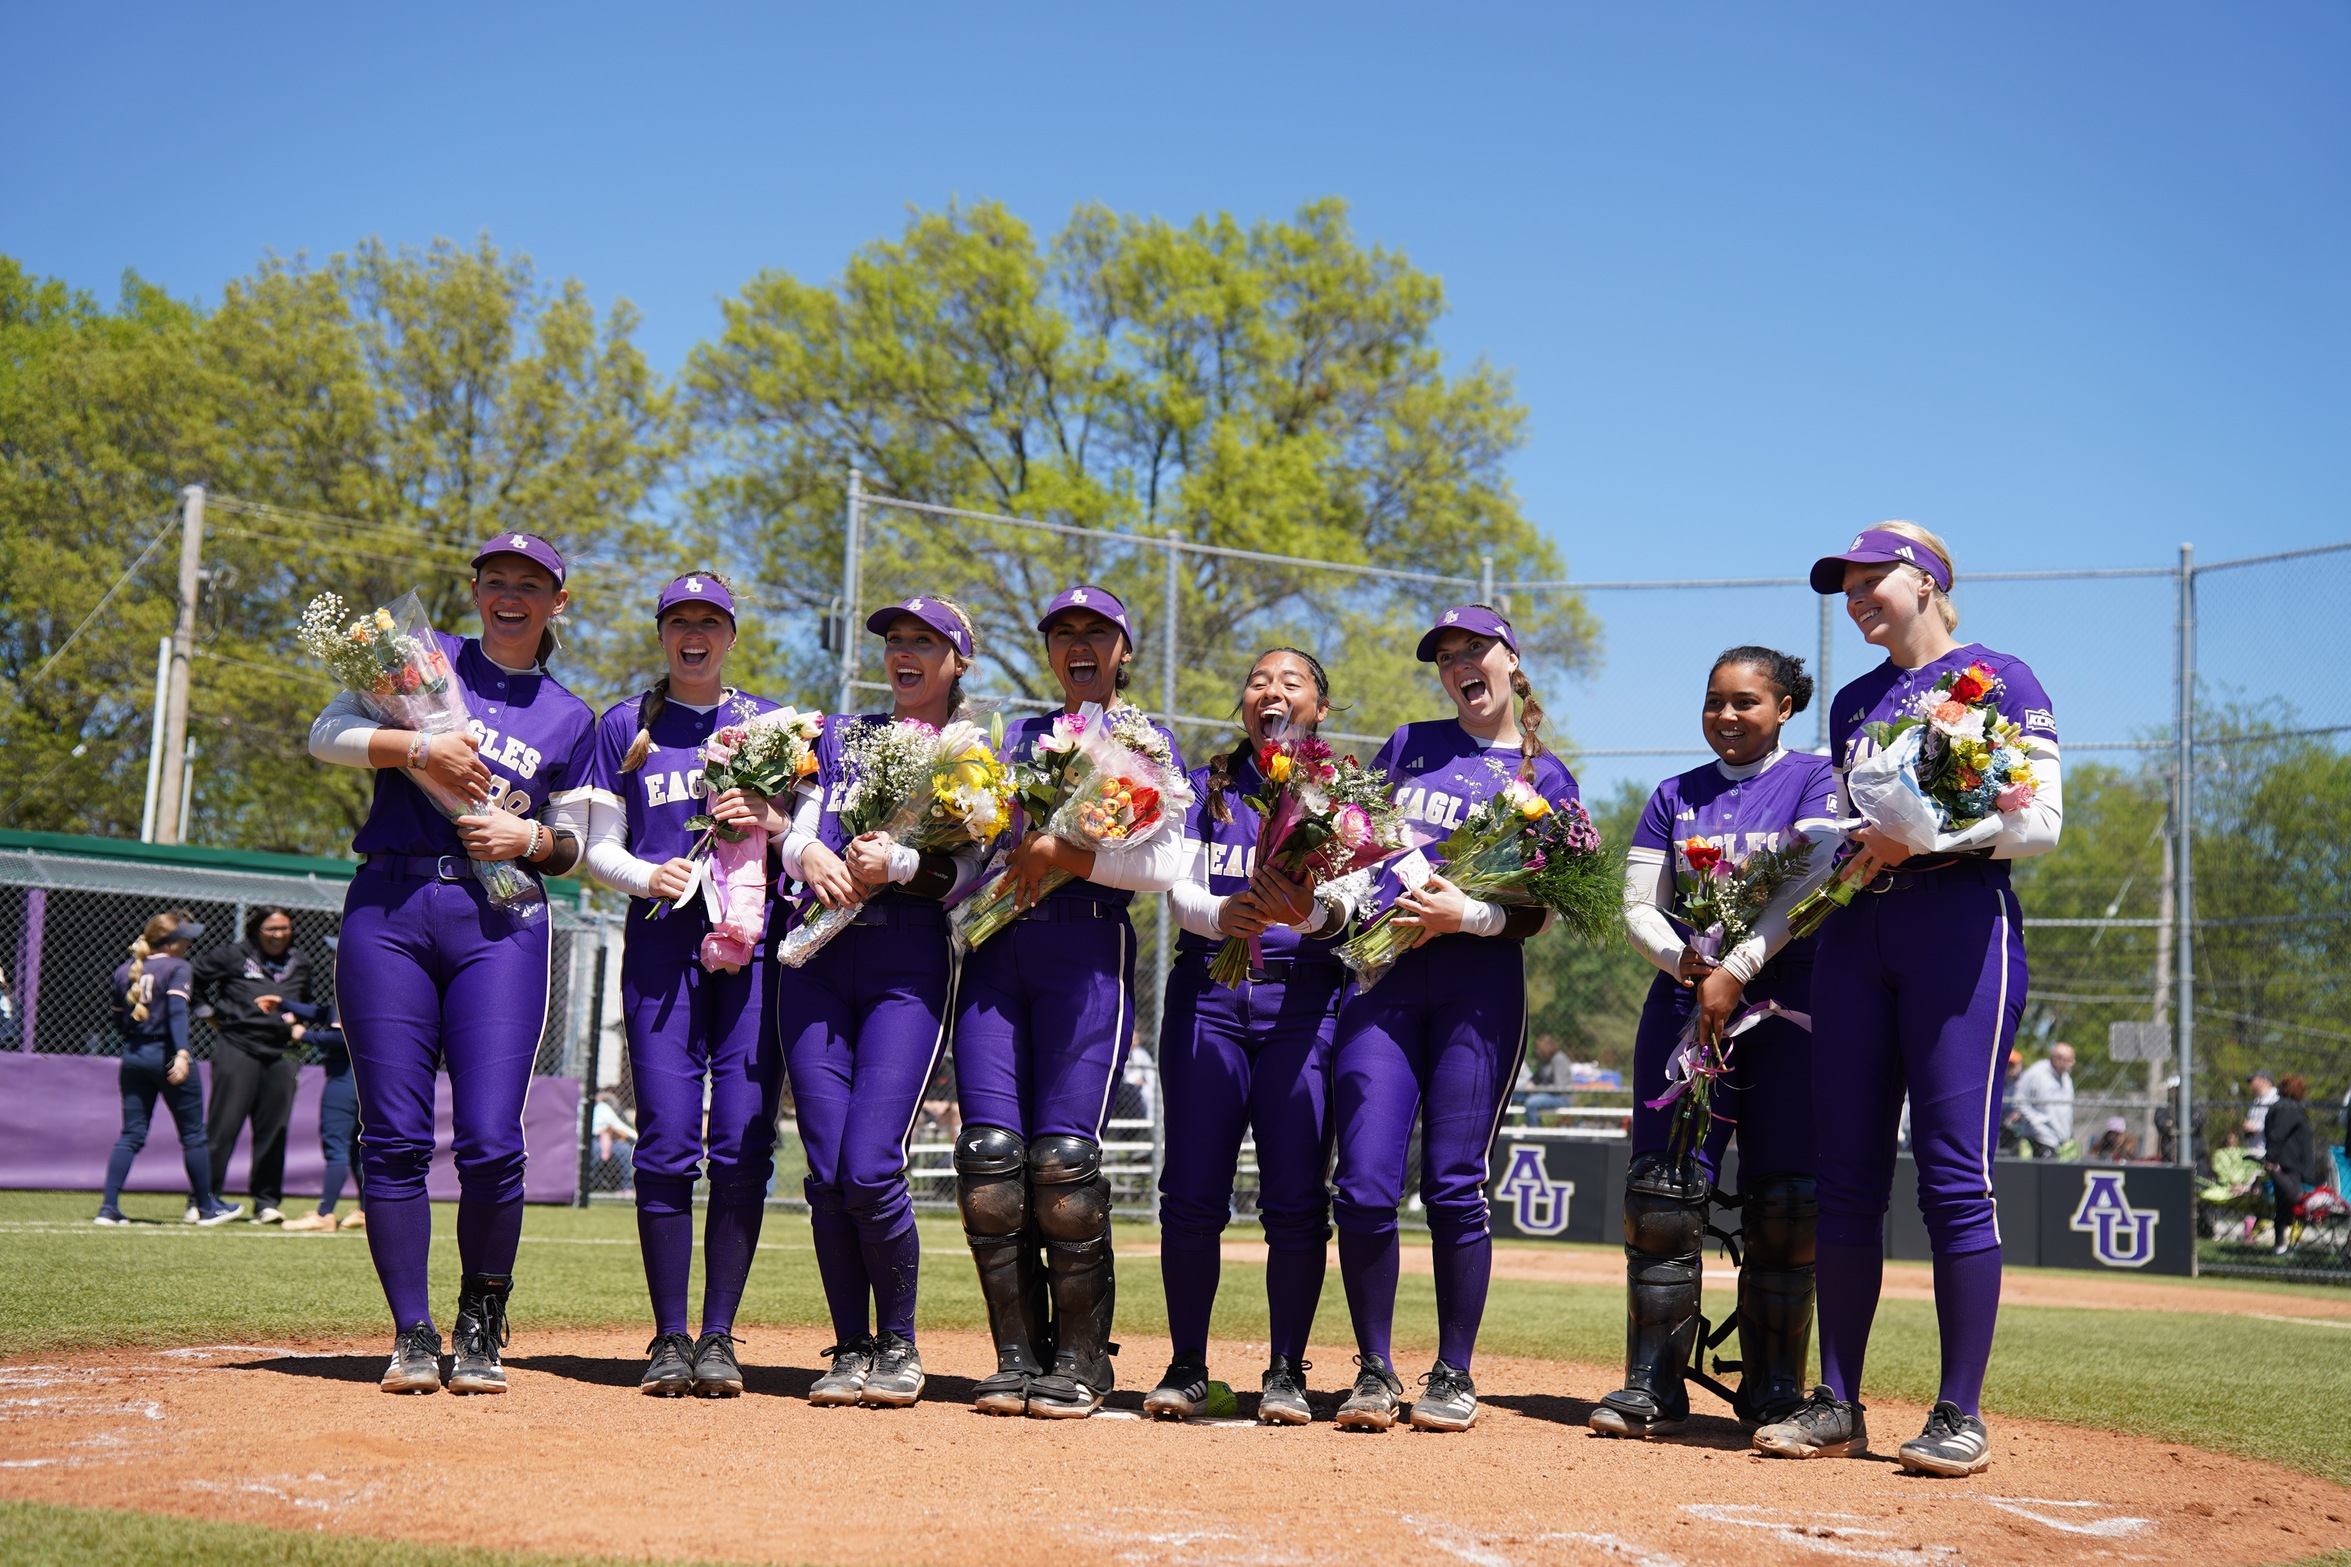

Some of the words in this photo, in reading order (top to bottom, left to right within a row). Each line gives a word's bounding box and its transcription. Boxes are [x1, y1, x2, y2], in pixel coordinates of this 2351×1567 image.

[467, 719, 541, 780] GLES
[644, 768, 708, 808] EAG
[1394, 787, 1487, 831] EAGL
[1494, 1143, 1574, 1236] AU
[2069, 1169, 2160, 1268] AU
